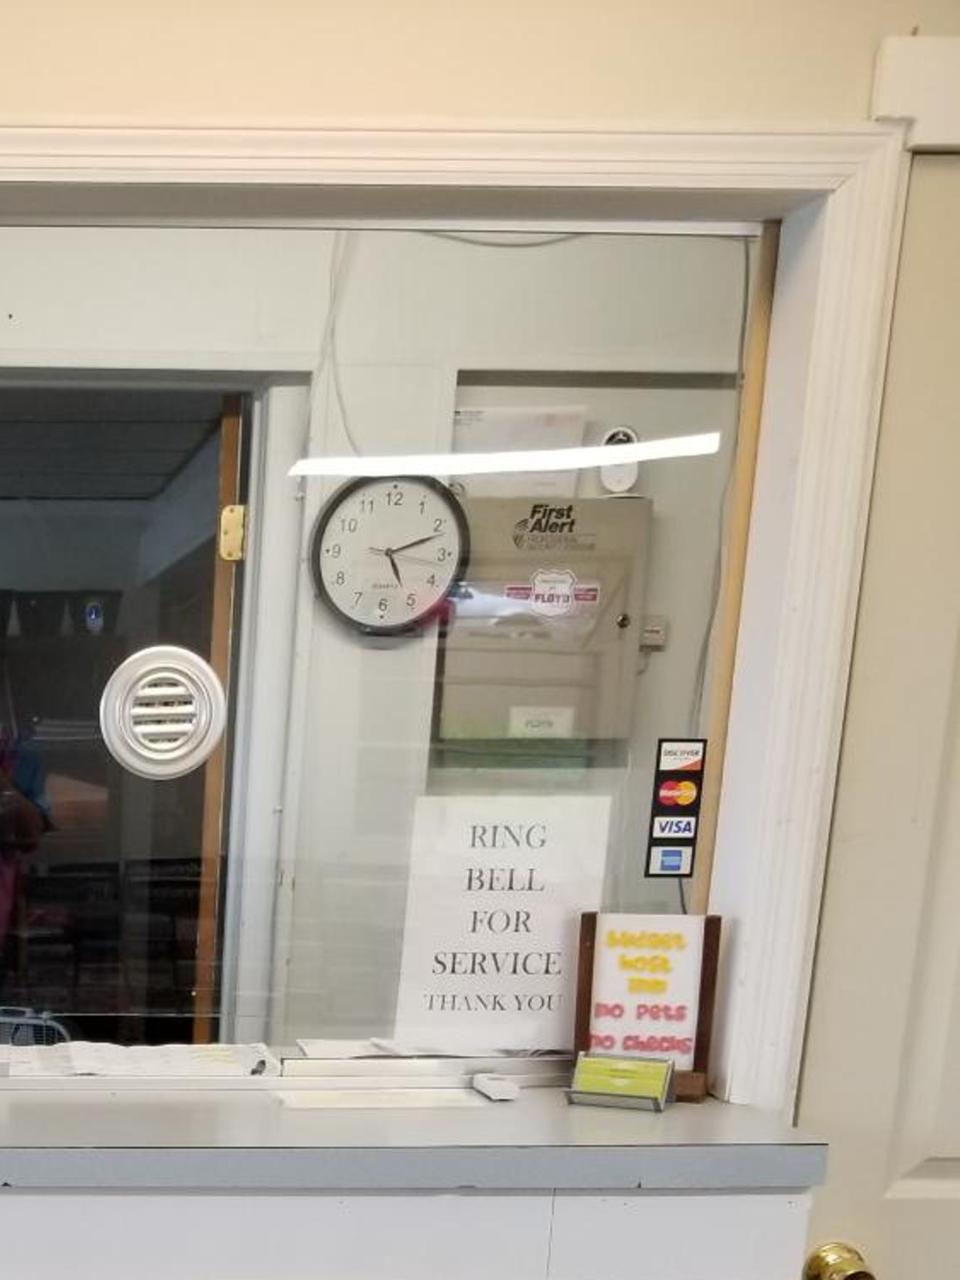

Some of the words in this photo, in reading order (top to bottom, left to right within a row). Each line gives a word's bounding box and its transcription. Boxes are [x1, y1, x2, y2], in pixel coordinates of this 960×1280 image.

[385, 491, 404, 506] 12
[529, 505, 573, 519] First
[433, 518, 443, 532] 2
[529, 519, 575, 533] Alert
[331, 544, 341, 558] 9
[437, 547, 446, 562] 3
[336, 571, 345, 586] 8
[426, 574, 436, 585] 4
[353, 591, 363, 606] 7
[378, 598, 388, 611] 6
[406, 593, 417, 607] 5
[659, 821, 692, 833] VISA
[470, 824, 546, 849] RING
[466, 867, 545, 892] BELL
[470, 910, 531, 933] FOR
[432, 952, 562, 976] SERVICE
[424, 994, 506, 1012] THANK
[514, 994, 563, 1012] YOU
